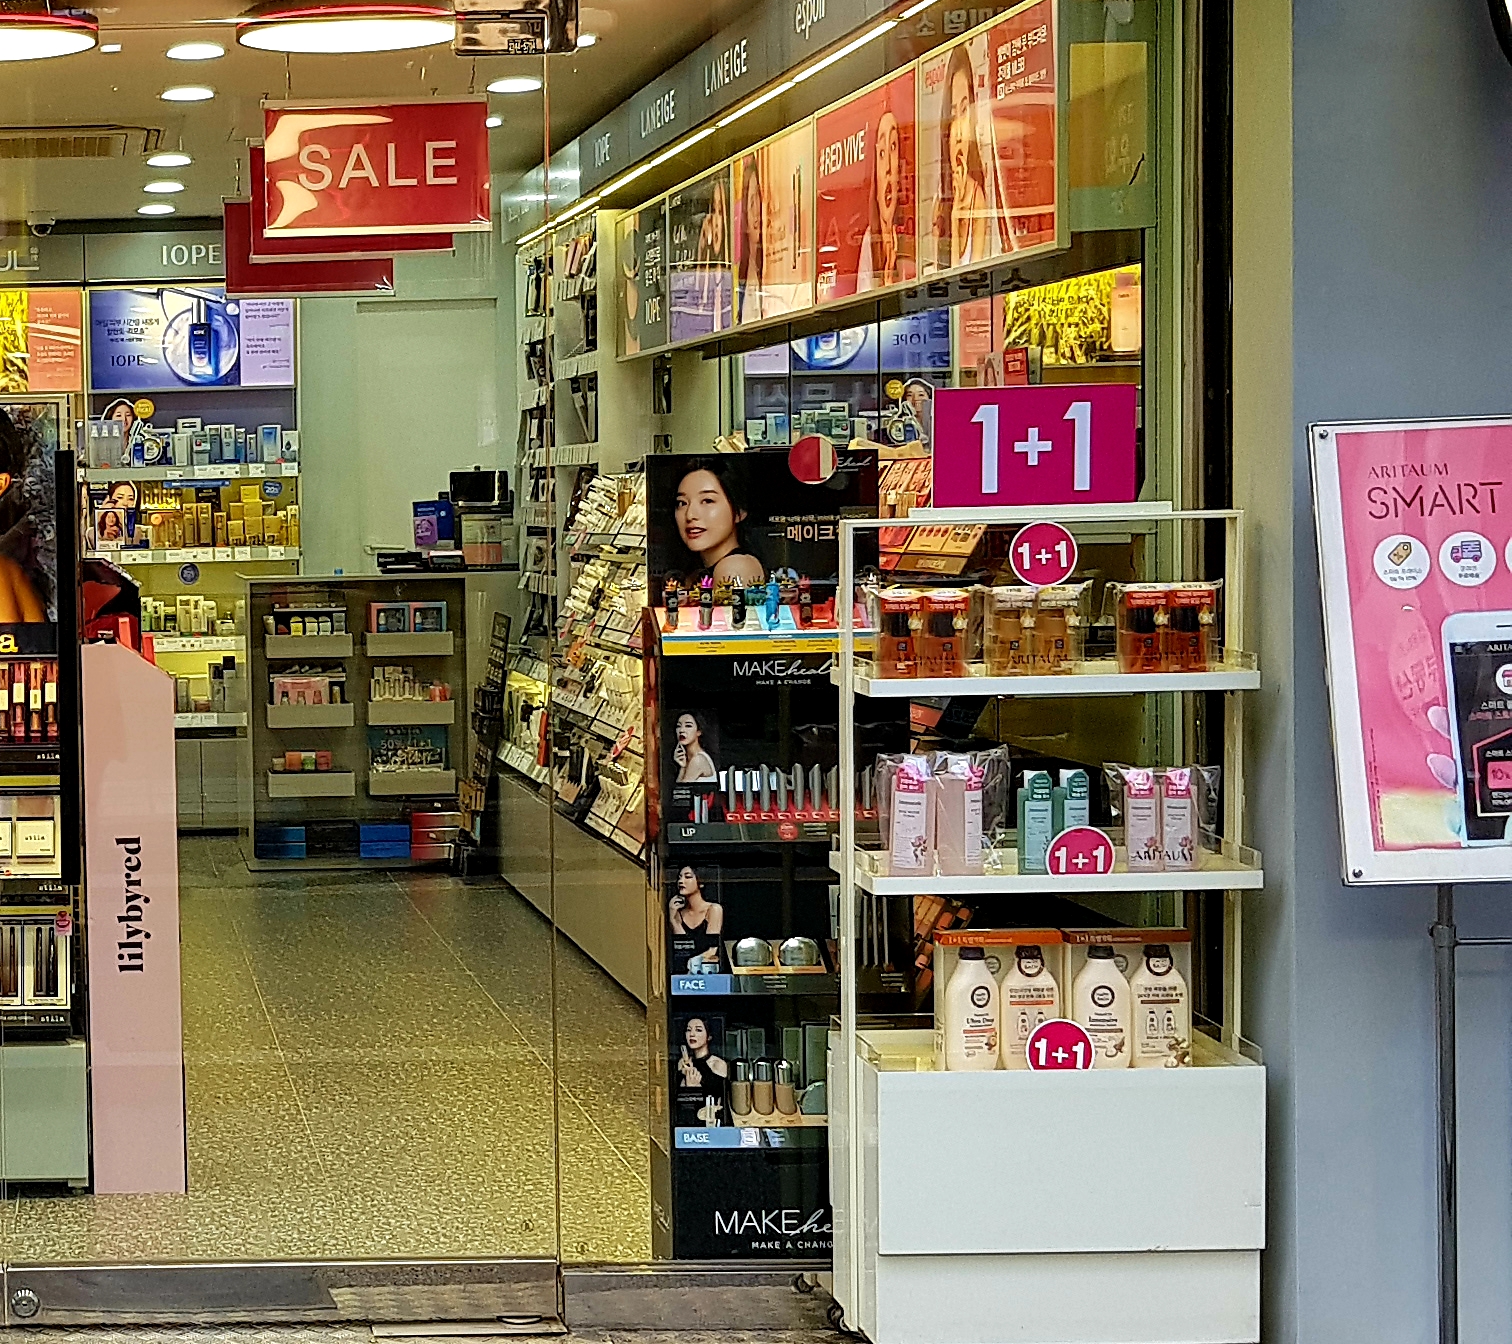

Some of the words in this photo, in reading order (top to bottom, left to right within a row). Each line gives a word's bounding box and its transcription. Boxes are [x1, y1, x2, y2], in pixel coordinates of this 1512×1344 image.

[704, 38, 748, 97] LANEIGE
[639, 88, 676, 139] LANEIGE
[593, 133, 611, 167] IOPE
[298, 140, 458, 192] SALE
[161, 244, 222, 266] IOPE
[111, 354, 145, 367] IOPE
[970, 401, 1093, 494] 1+1
[1368, 463, 1449, 478] ARITAUM
[1367, 481, 1503, 519] SMART
[786, 523, 839, 543] 메이크
[1017, 540, 1068, 570] 1+1
[681, 827, 696, 837] LIP
[1054, 845, 1107, 873] 1+1
[115, 836, 152, 974] lilybyred
[679, 979, 705, 990] FACE
[1034, 1037, 1085, 1069] 1+1
[683, 1132, 710, 1144] BASE
[715, 1208, 834, 1236] MAKEhe
[751, 1241, 781, 1250] MAKE
[785, 1240, 794, 1249] A
